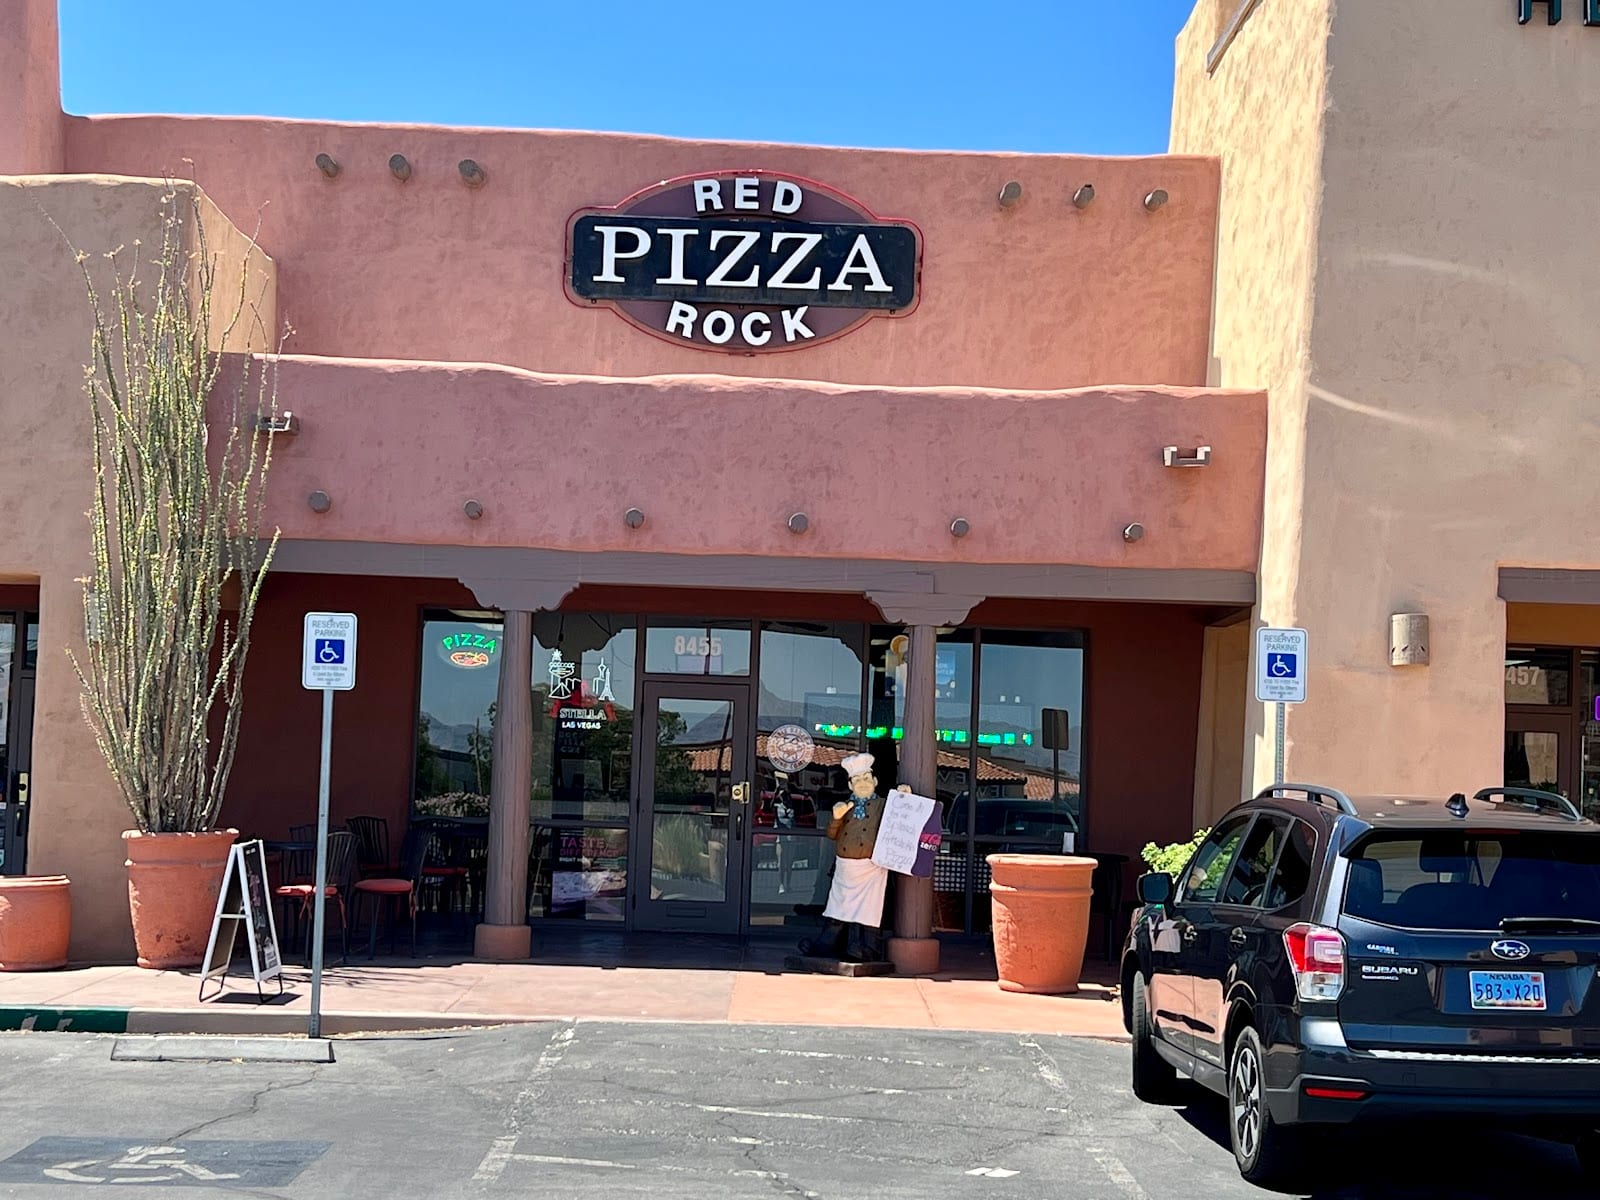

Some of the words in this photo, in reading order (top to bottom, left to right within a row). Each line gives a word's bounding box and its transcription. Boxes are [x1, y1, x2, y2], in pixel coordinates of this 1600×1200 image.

[693, 177, 803, 214] RED
[592, 225, 894, 292] PIZZA
[665, 300, 816, 346] ROCK
[312, 620, 350, 629] RESERVED
[315, 629, 346, 637] PARKING
[442, 633, 497, 654] PIZZA
[1264, 635, 1301, 644] RESERVED
[674, 635, 722, 656] 8455
[1266, 643, 1298, 652] PARKING
[560, 708, 607, 720] STELLA
[562, 721, 576, 729] LAS
[577, 722, 601, 730] VEGAS
[560, 836, 605, 849] TASTE
[919, 841, 938, 851] zero
[1362, 965, 1418, 975] SUBARU
[1489, 973, 1525, 981] NEVADA
